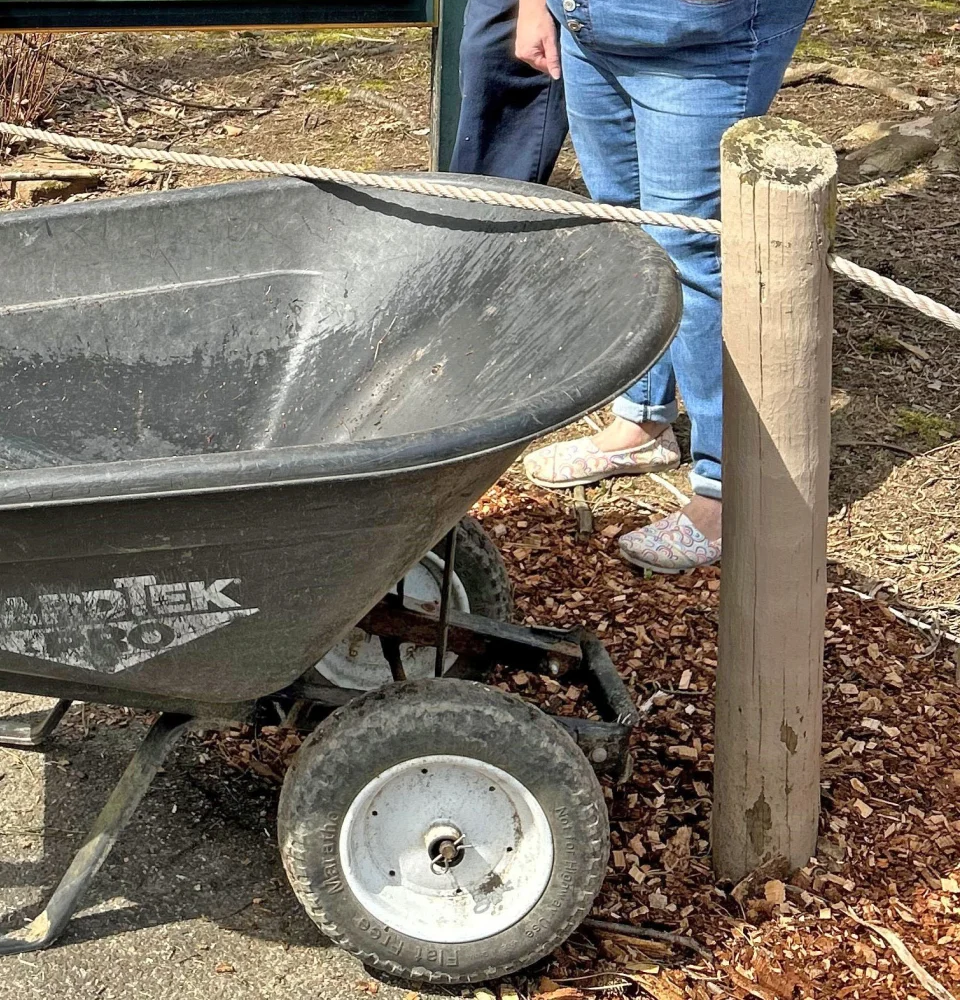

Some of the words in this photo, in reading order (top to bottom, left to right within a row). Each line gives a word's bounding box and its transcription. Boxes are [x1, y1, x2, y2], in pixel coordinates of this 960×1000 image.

[555, 806, 573, 831] Not
[319, 811, 344, 894] Maratho
[358, 919, 404, 956] Free
[525, 917, 551, 939] Use
[414, 949, 459, 967] Flat
